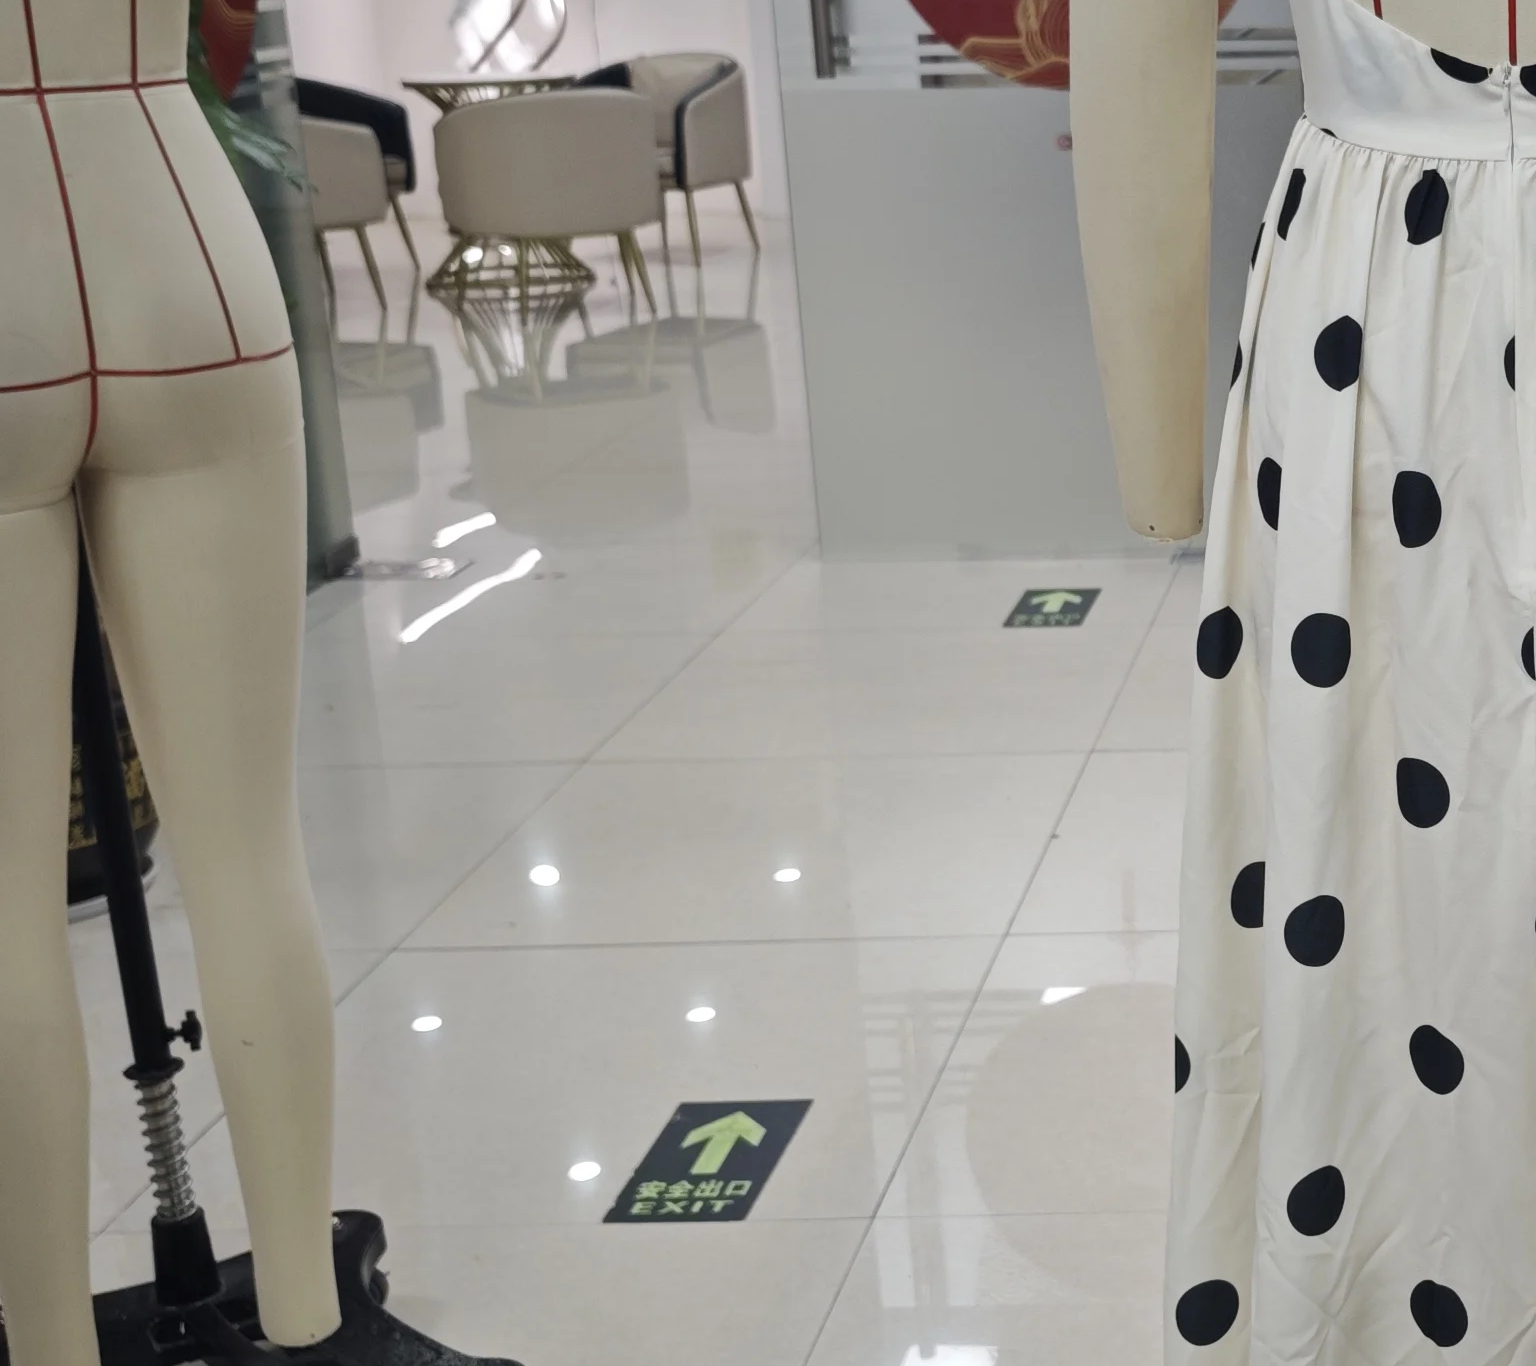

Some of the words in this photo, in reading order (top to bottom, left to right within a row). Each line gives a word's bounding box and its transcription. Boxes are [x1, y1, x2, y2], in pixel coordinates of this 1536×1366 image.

[635, 1179, 752, 1199] 安全出口
[629, 1199, 735, 1215] EXIT
